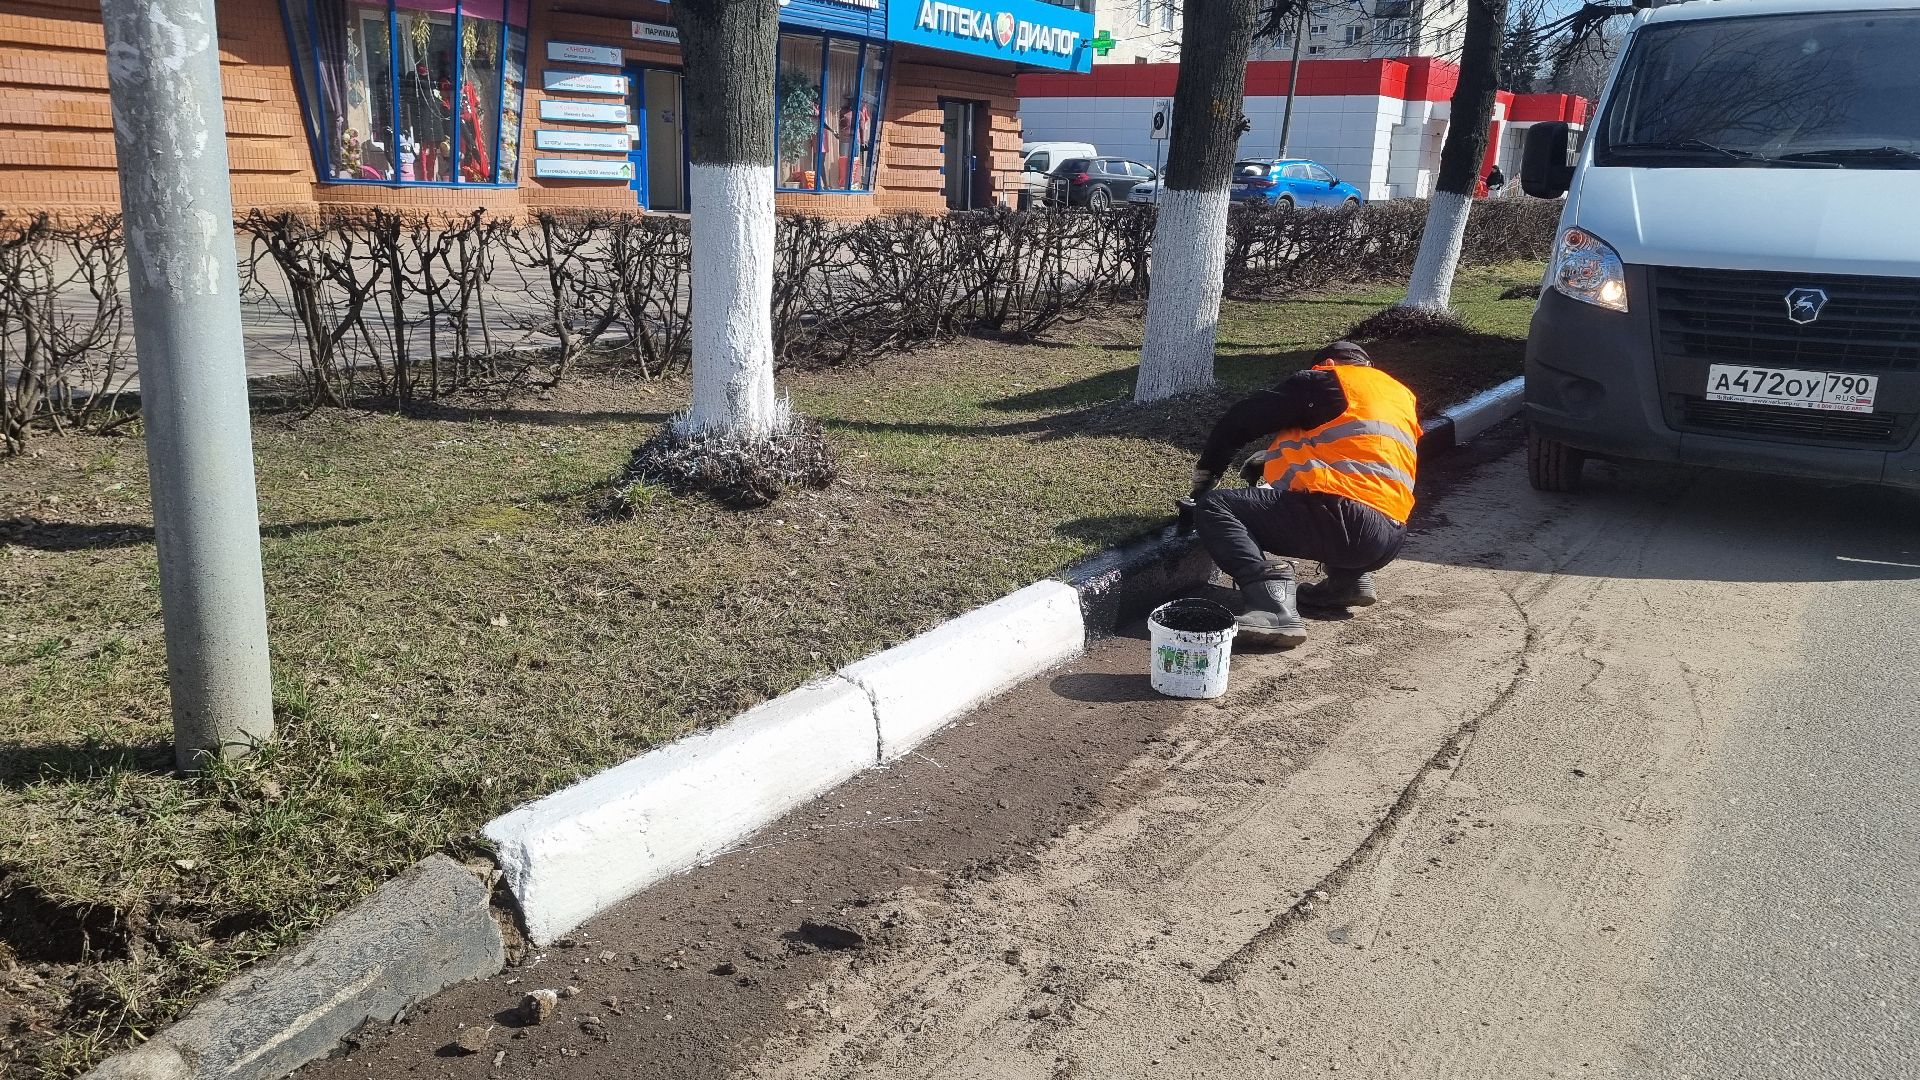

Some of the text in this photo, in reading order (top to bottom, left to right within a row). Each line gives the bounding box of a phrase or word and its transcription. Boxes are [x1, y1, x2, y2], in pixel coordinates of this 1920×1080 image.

[919, 2, 1080, 55] АПТЕКА ДИАЛОГ
[1715, 369, 1870, 398] А472ОУ 790
[1835, 394, 1856, 403] RUS
